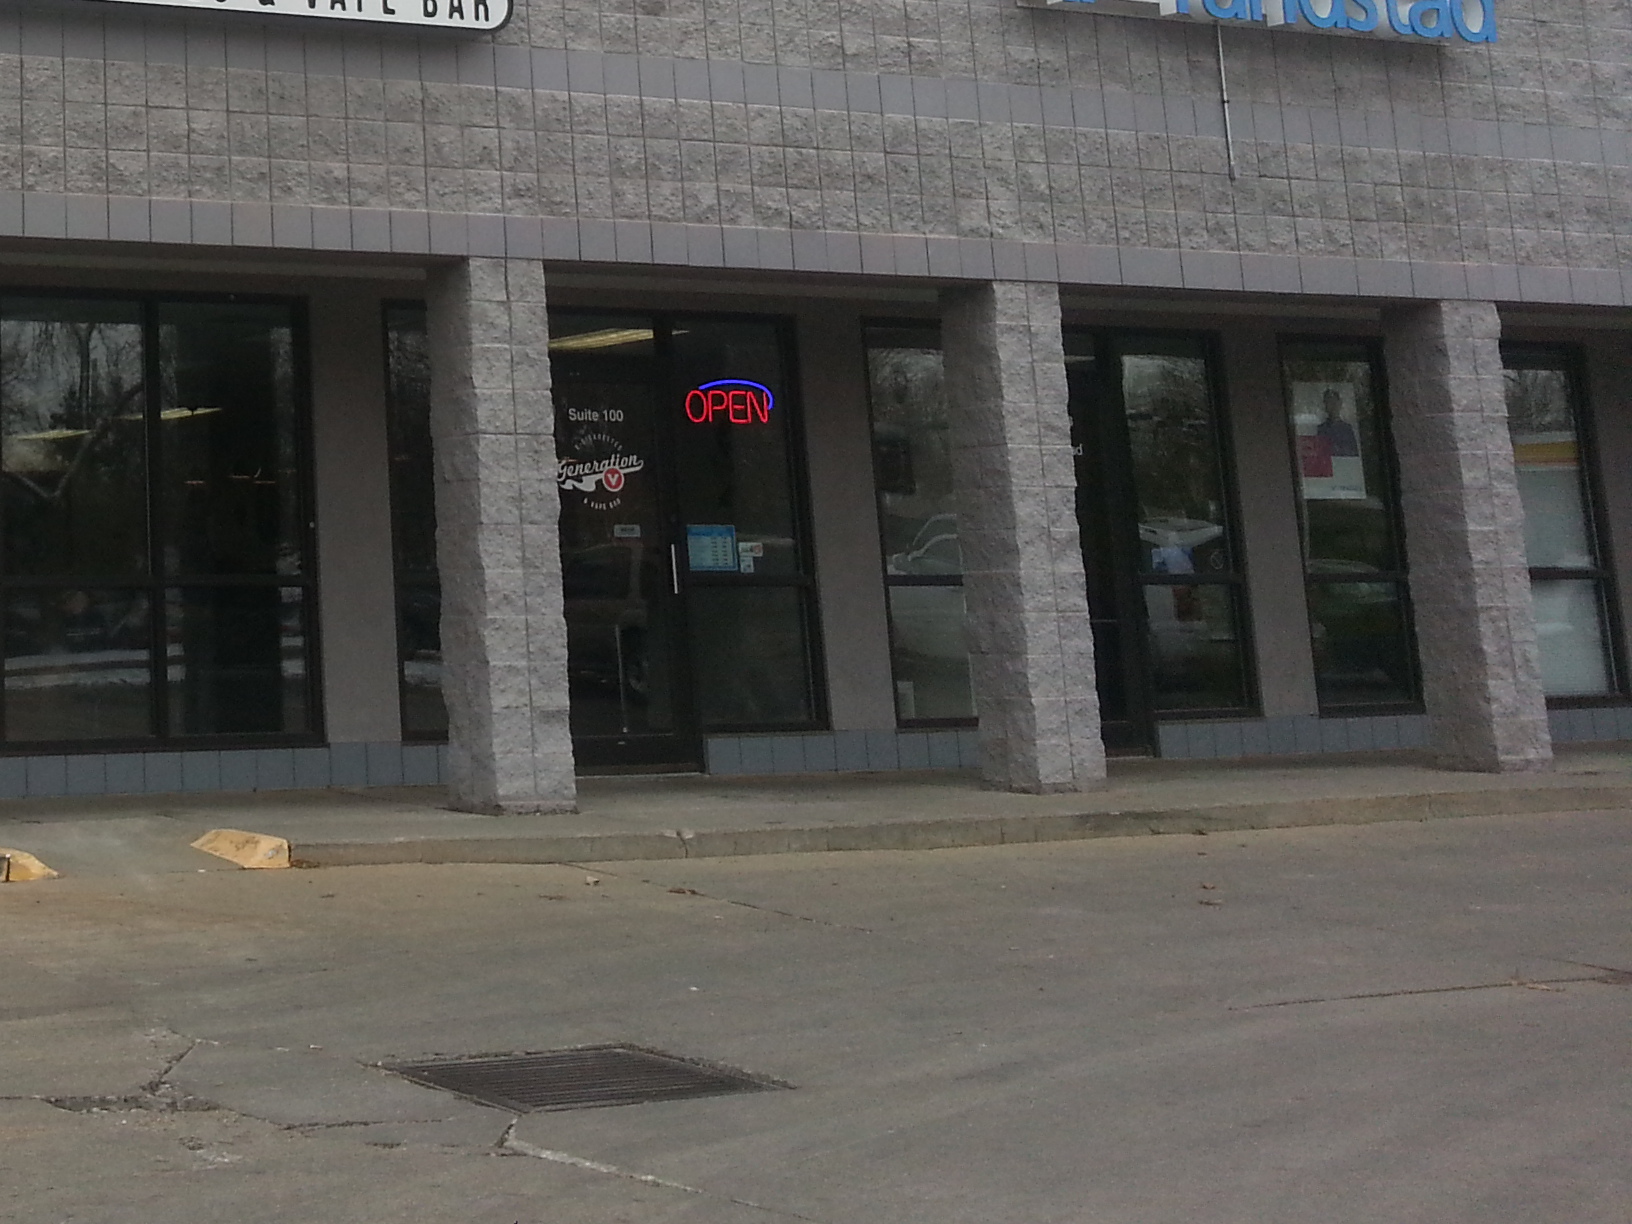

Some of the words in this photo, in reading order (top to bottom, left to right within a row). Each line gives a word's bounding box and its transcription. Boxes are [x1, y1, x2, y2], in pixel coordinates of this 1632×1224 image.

[568, 407, 600, 422] Suite
[603, 409, 625, 423] 100
[685, 389, 769, 424] OPEN
[557, 453, 638, 482] Generation
[607, 473, 620, 487] V
